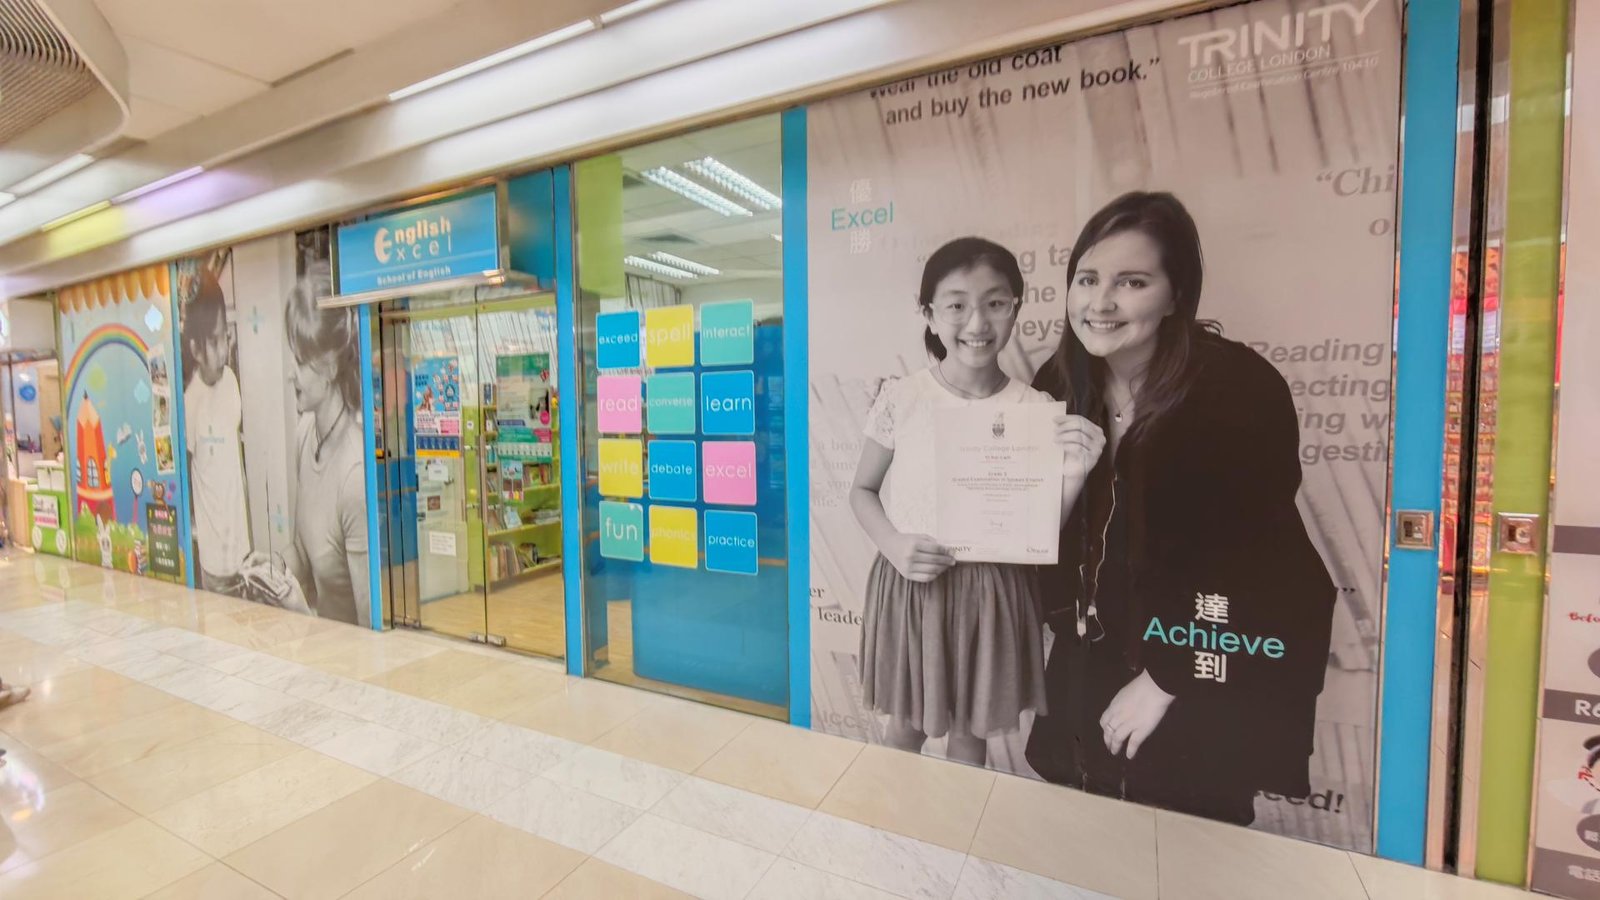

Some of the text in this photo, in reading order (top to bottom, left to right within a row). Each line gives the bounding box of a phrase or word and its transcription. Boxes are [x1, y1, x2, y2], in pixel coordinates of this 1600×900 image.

[1178, 0, 1379, 67] TRINITY
[1012, 46, 1062, 71] coat
[1188, 45, 1332, 83] COLLEGE LONDON
[886, 102, 922, 125] and
[931, 97, 969, 119] buy
[979, 89, 1012, 108] the
[1023, 77, 1070, 101] new
[832, 201, 894, 231] Excel
[377, 272, 405, 287] School
[417, 264, 452, 280] English
[598, 331, 639, 345] exceed
[647, 321, 691, 347] spell
[702, 323, 750, 339] interact
[600, 394, 638, 412] read
[648, 397, 694, 409] converse
[705, 394, 752, 412] learn
[601, 458, 639, 475] write
[651, 462, 692, 475] debate
[705, 461, 752, 480] excel
[605, 516, 638, 541] fun
[708, 534, 755, 549] practice
[1194, 591, 1230, 625] 達
[1142, 616, 1286, 660] Achieve
[1193, 650, 1228, 684] 到
